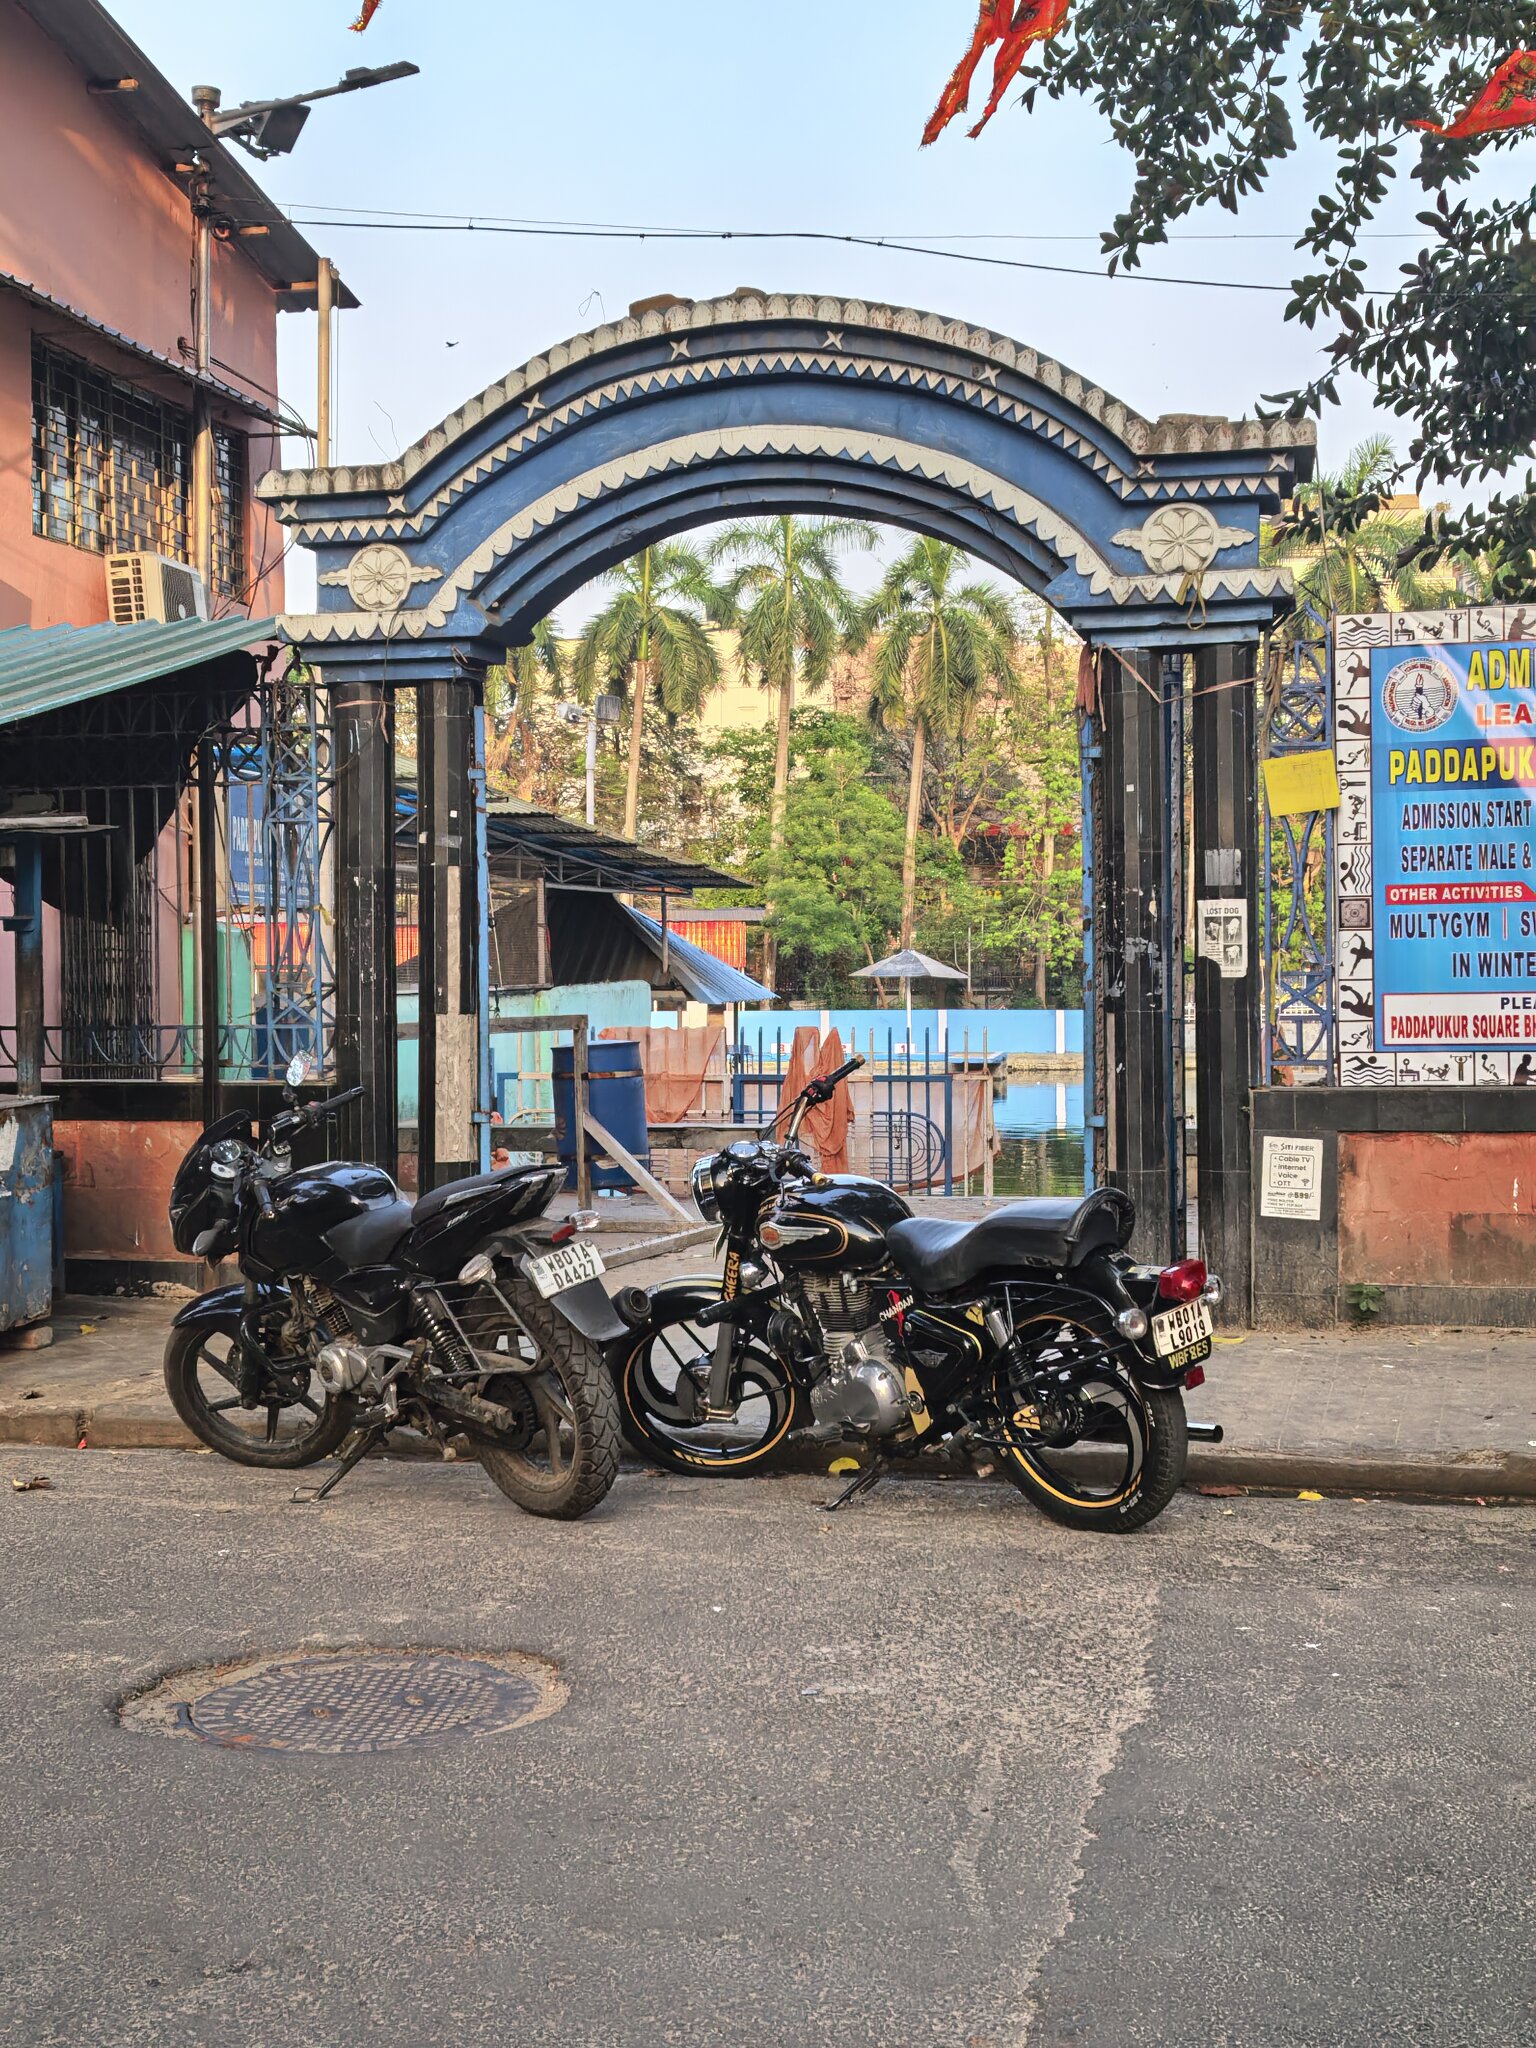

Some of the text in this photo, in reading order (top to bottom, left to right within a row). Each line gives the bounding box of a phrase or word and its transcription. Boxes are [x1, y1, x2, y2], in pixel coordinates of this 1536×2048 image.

[1466, 648, 1536, 691] ADM
[1476, 703, 1533, 726] LEA
[1389, 745, 1535, 785] PADDAPUK
[1402, 800, 1532, 830] ADMISSION START
[1401, 842, 1532, 872] SEPARATE MALE &
[1390, 885, 1523, 901] OTHER ACTIVITIES
[1206, 907, 1239, 915] LOST DOG
[1390, 911, 1536, 939] MULTYGYM S
[1453, 952, 1536, 978] IN WINTE
[1391, 1015, 1468, 1039] PADDAPUKUR
[1473, 1015, 1520, 1039] SQUARE
[1278, 1155, 1300, 1163] Cable
[544, 1243, 591, 1273] WB01A
[552, 1258, 597, 1290] D4427
[879, 1294, 914, 1322] CHANDAN
[1167, 1300, 1203, 1332] WB01A
[1170, 1319, 1206, 1350] L9019
